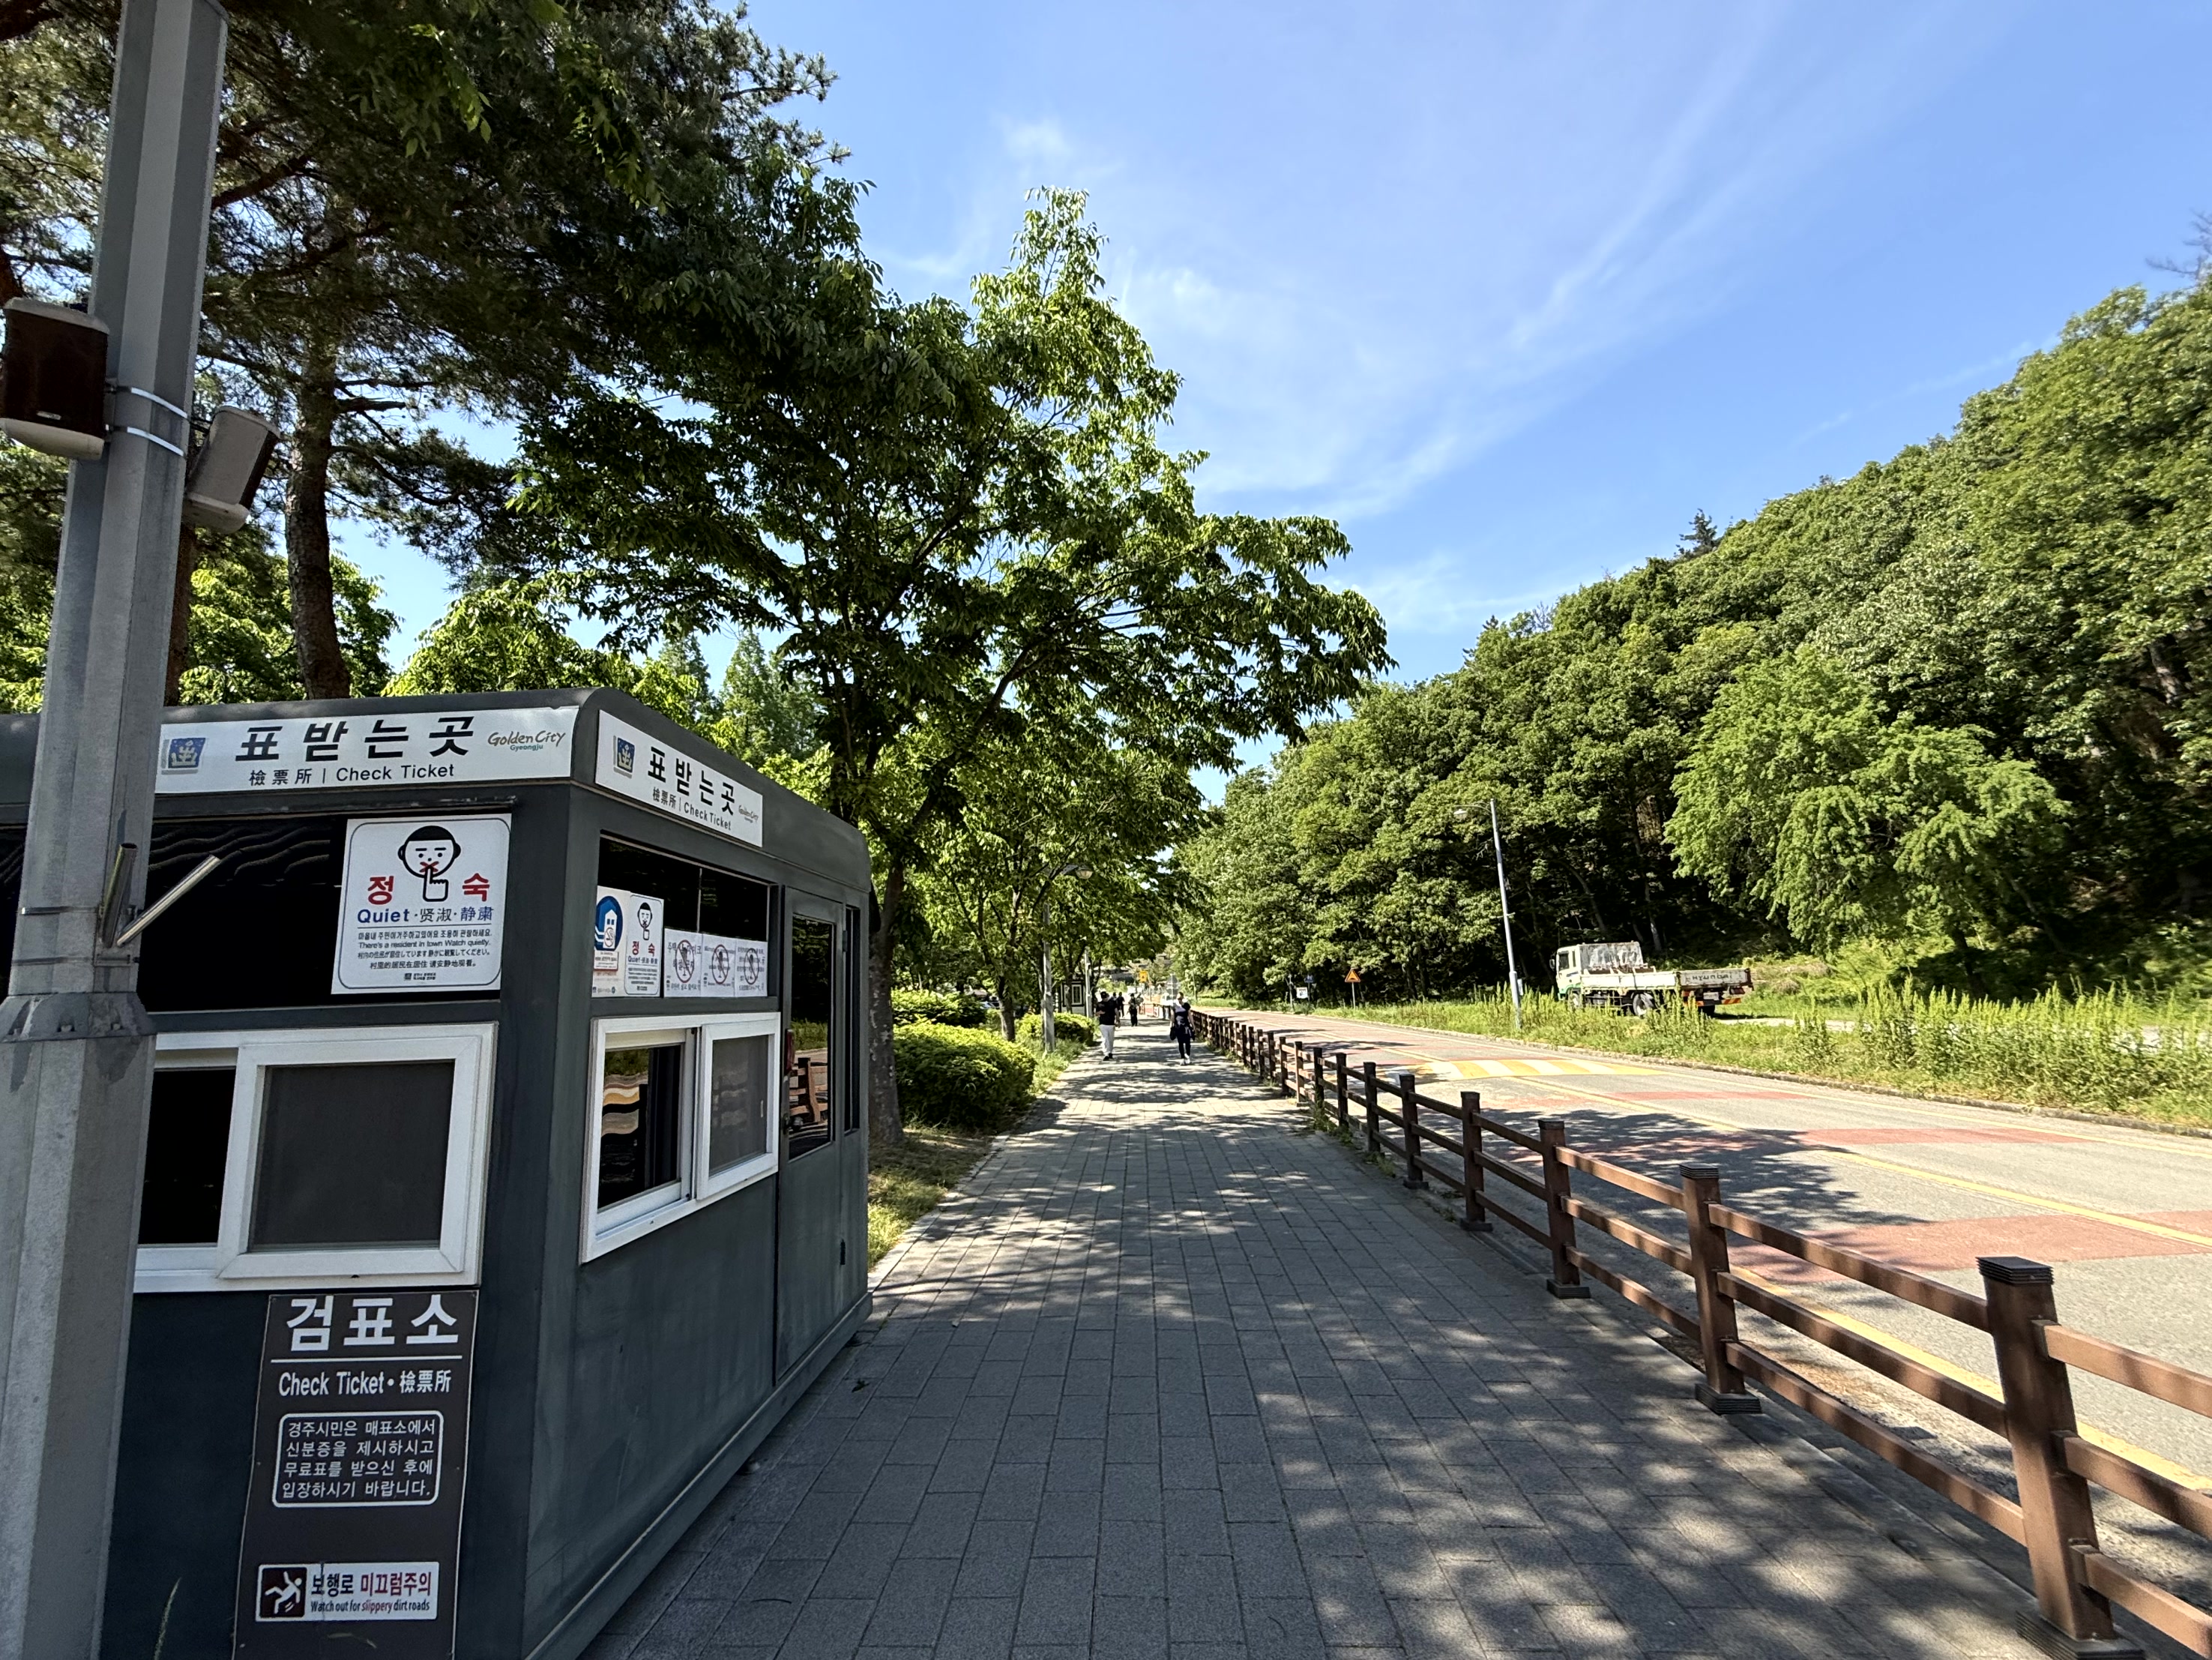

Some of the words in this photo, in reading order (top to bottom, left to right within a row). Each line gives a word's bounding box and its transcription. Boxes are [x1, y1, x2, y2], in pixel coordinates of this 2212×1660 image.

[510, 744, 543, 752] Gyeongju
[337, 766, 392, 781] Check
[400, 764, 454, 779] Ticket
[684, 802, 708, 822] Check
[709, 812, 732, 831] Ticket
[358, 908, 410, 923] Quiet
[286, 1294, 459, 1351] 검표소
[278, 1371, 330, 1396] Check
[337, 1371, 385, 1395] Ticket
[288, 1420, 358, 1437] 경주시민은
[365, 1419, 436, 1436] 매표소에서
[286, 1440, 347, 1458] 신분증을
[356, 1440, 435, 1456] 제시하시고
[283, 1461, 343, 1478] 무료표를
[351, 1460, 395, 1477] 받으신
[403, 1458, 433, 1476] 후에
[283, 1481, 356, 1499] 입장하시기
[365, 1479, 430, 1497] 바랍니다.
[311, 1573, 354, 1597] 보행로
[361, 1572, 432, 1597] 미끄럼주의
[310, 1599, 334, 1612] Watch
[335, 1600, 349, 1611] out
[349, 1599, 361, 1611] for
[361, 1599, 393, 1614] slippery
[394, 1599, 408, 1611] dirt
[409, 1599, 430, 1611] roads
